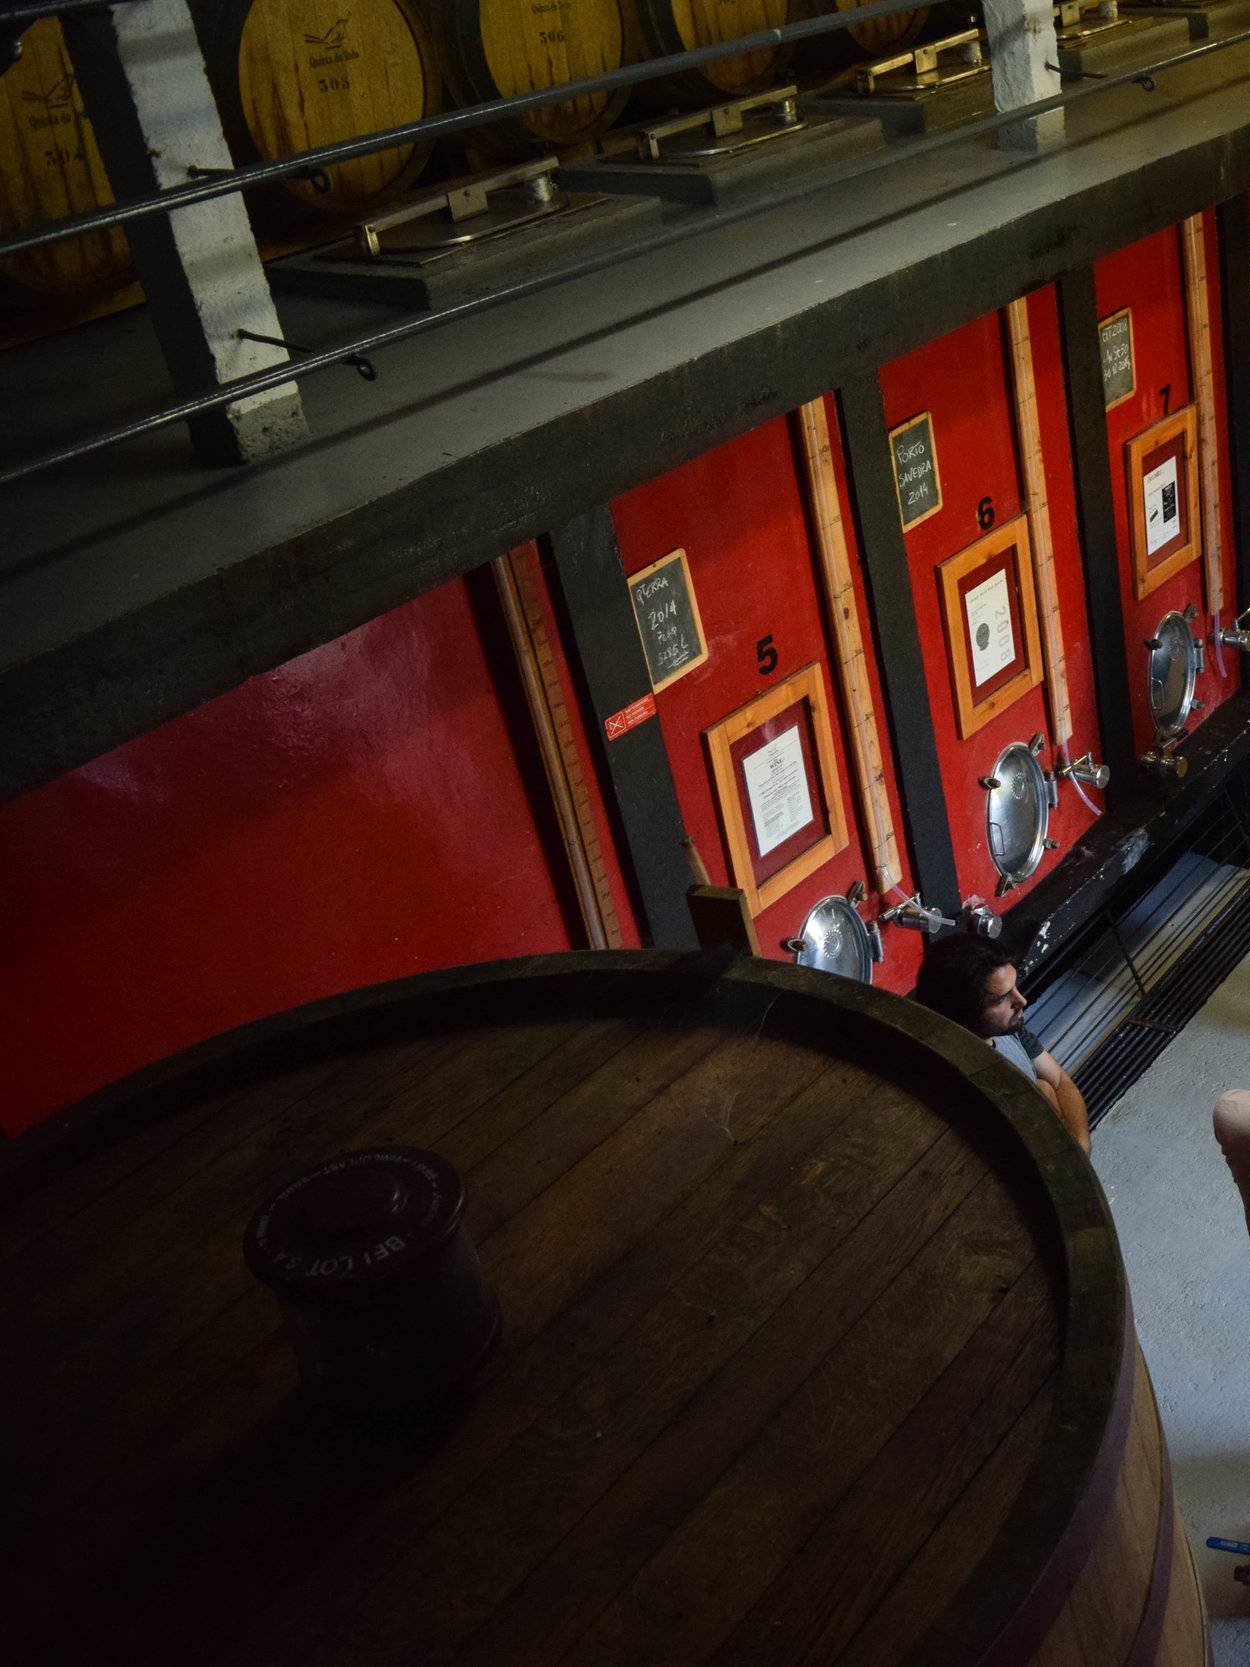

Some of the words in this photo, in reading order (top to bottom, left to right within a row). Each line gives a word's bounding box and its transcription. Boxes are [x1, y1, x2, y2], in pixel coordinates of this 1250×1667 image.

[1159, 384, 1171, 416] 7
[896, 441, 925, 464] PORTO
[908, 482, 929, 505] 2014
[977, 496, 995, 530] 6
[648, 600, 678, 631] 2014
[756, 634, 778, 675] 5
